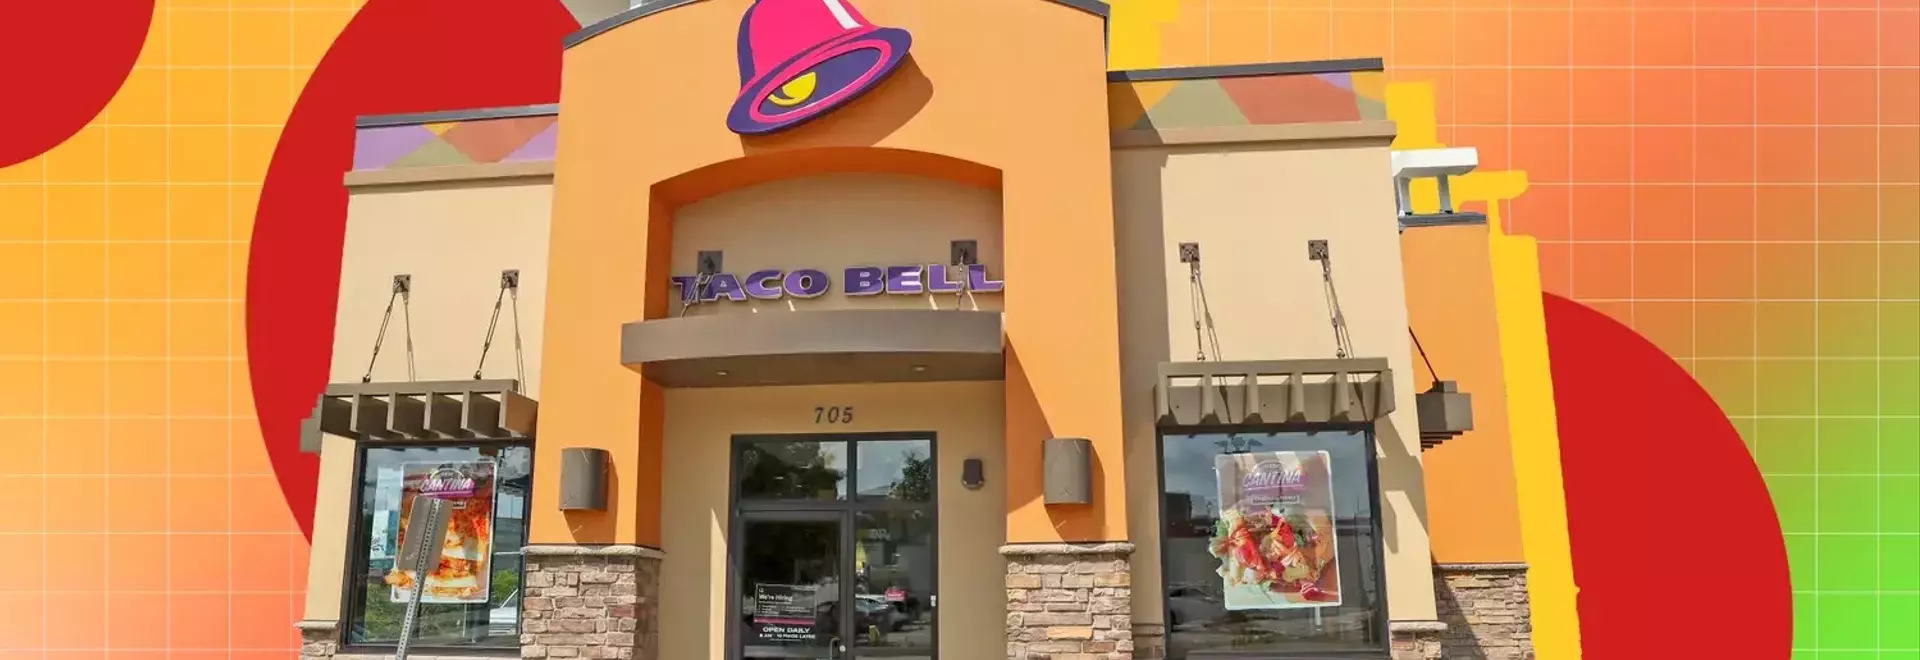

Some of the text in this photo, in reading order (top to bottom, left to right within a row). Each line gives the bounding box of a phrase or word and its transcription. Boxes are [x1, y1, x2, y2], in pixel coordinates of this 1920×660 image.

[672, 264, 1004, 301] TACO BELL
[815, 406, 853, 424] 705
[420, 478, 473, 493] CANTINA
[1243, 470, 1301, 488] CANTINA
